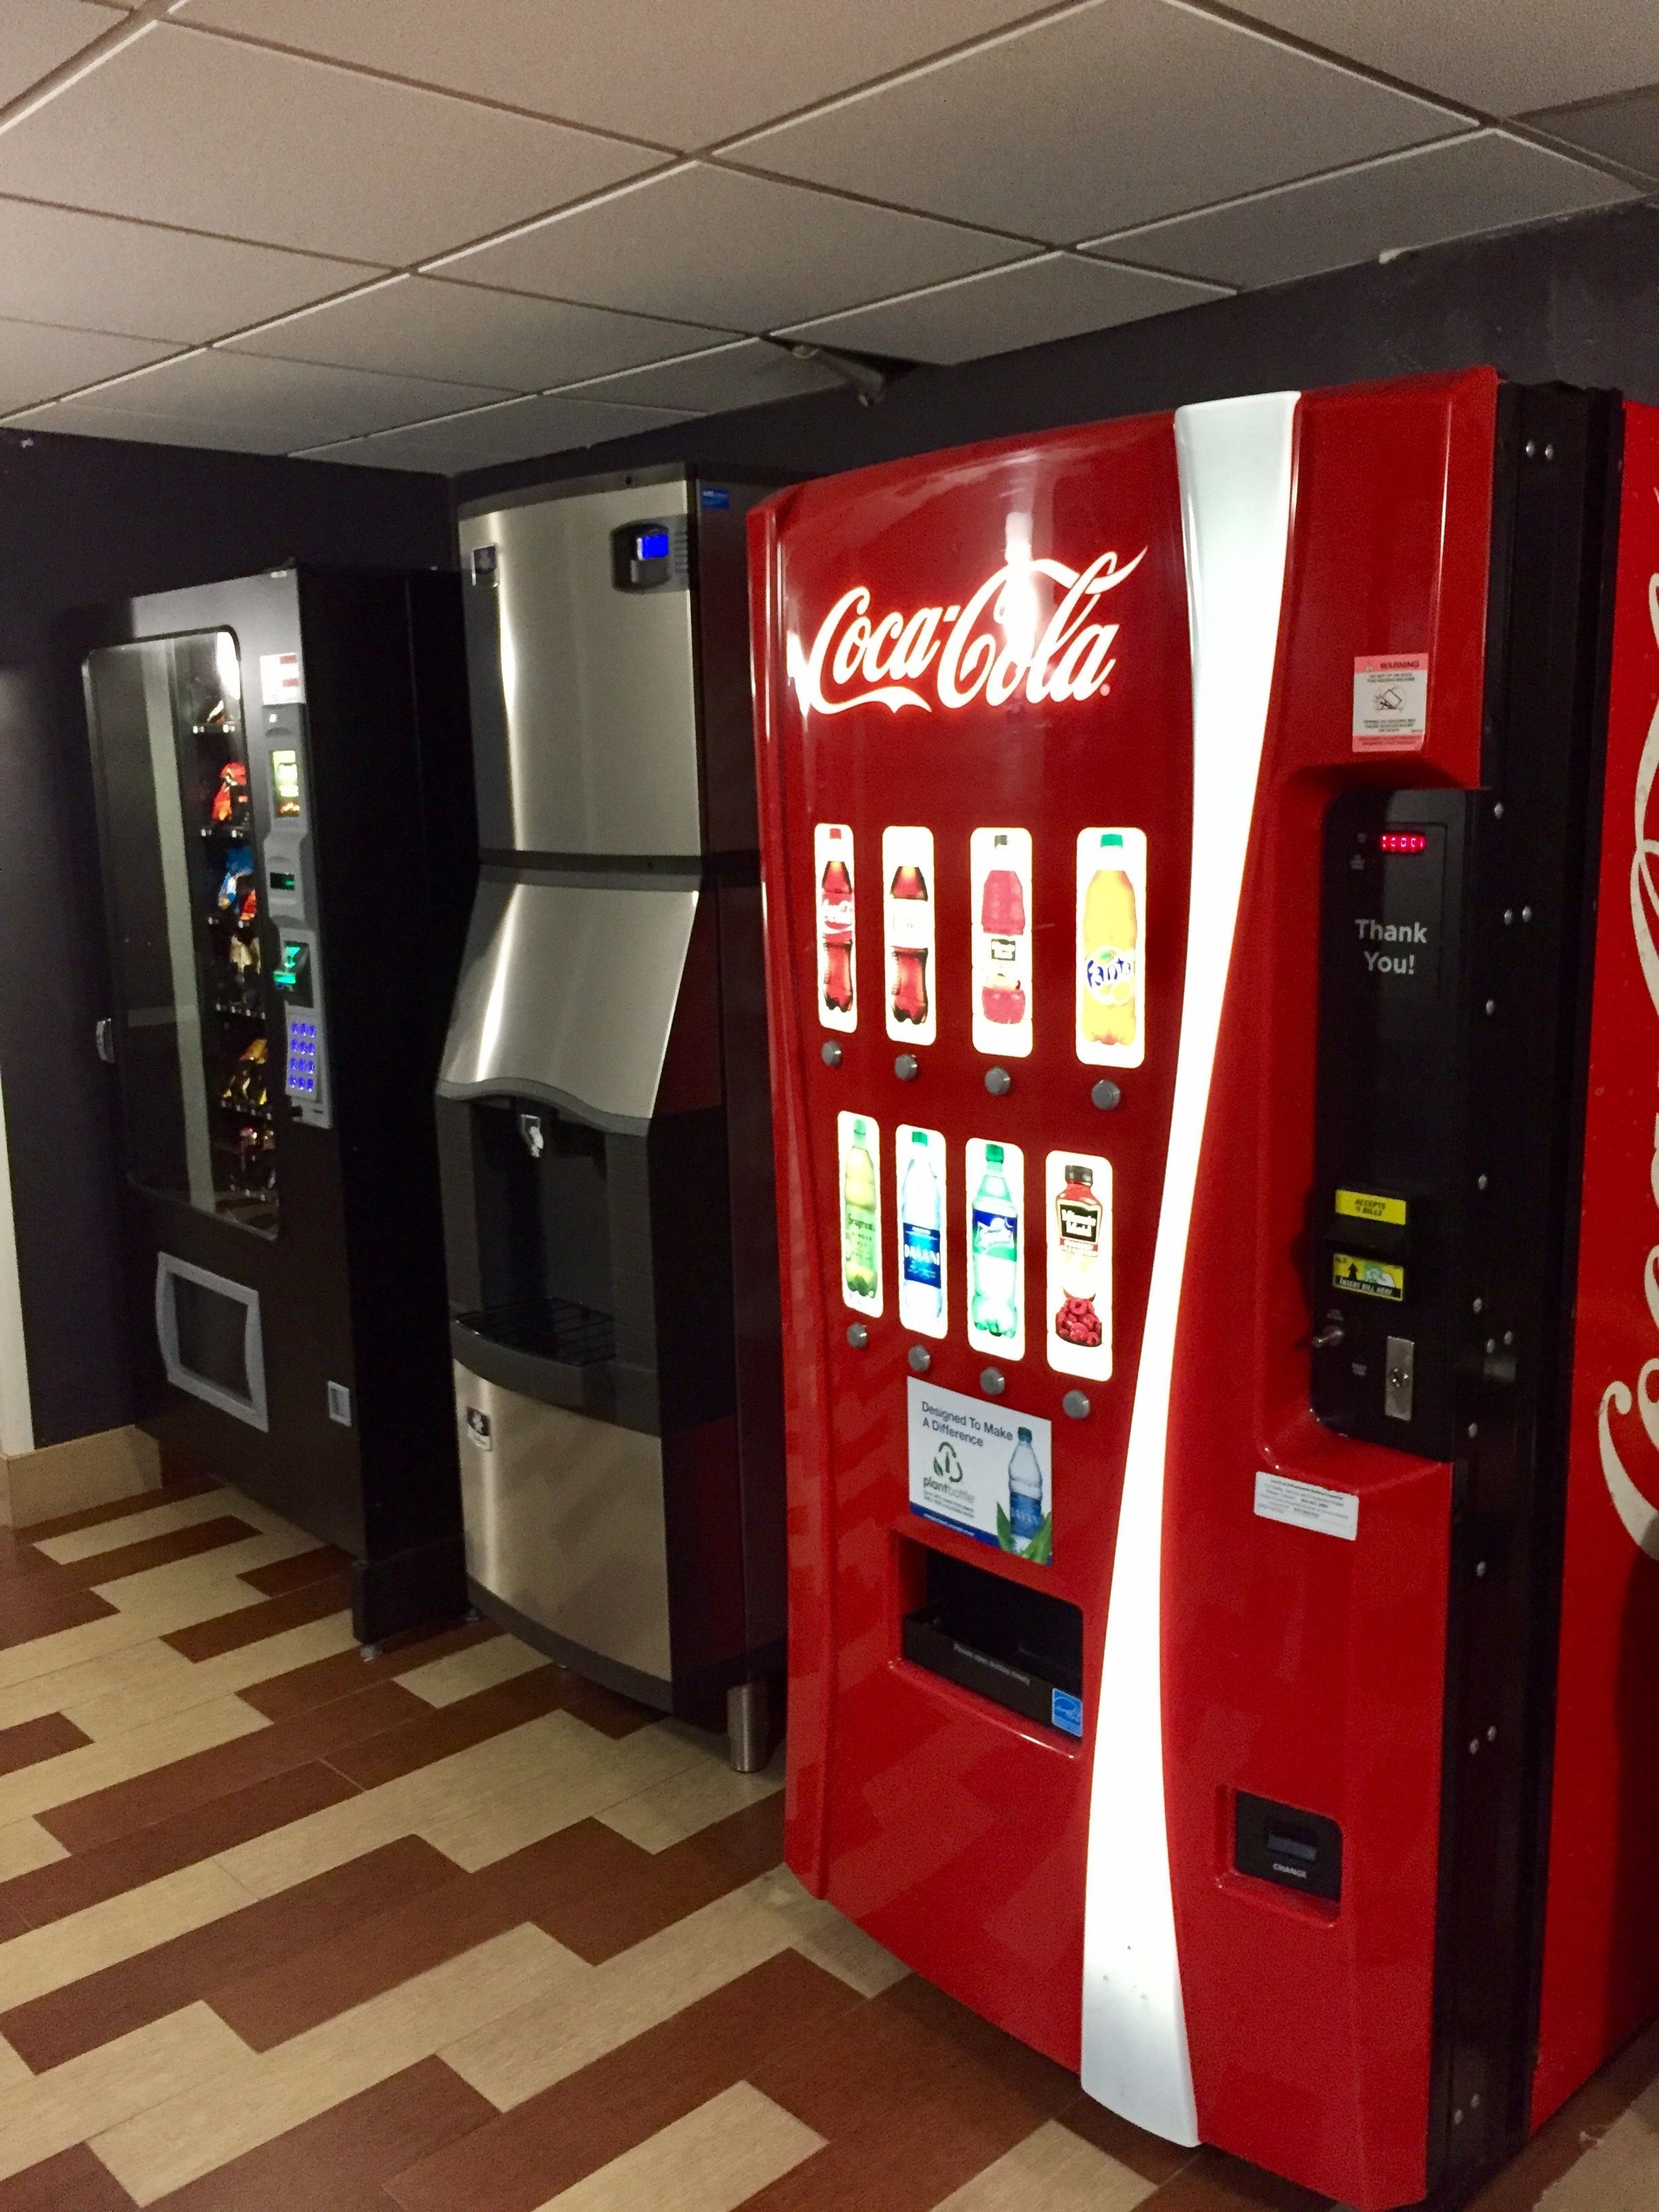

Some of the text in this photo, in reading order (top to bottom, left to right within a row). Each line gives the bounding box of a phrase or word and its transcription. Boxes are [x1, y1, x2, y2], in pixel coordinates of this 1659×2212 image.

[806, 546, 1148, 714] Coca-Cola
[1380, 660, 1420, 669] WARNING
[1355, 919, 1427, 943] Thank
[1364, 950, 1415, 975] You!
[922, 1401, 1013, 1441] Designed To Make
[922, 1417, 984, 1447] A Difference
